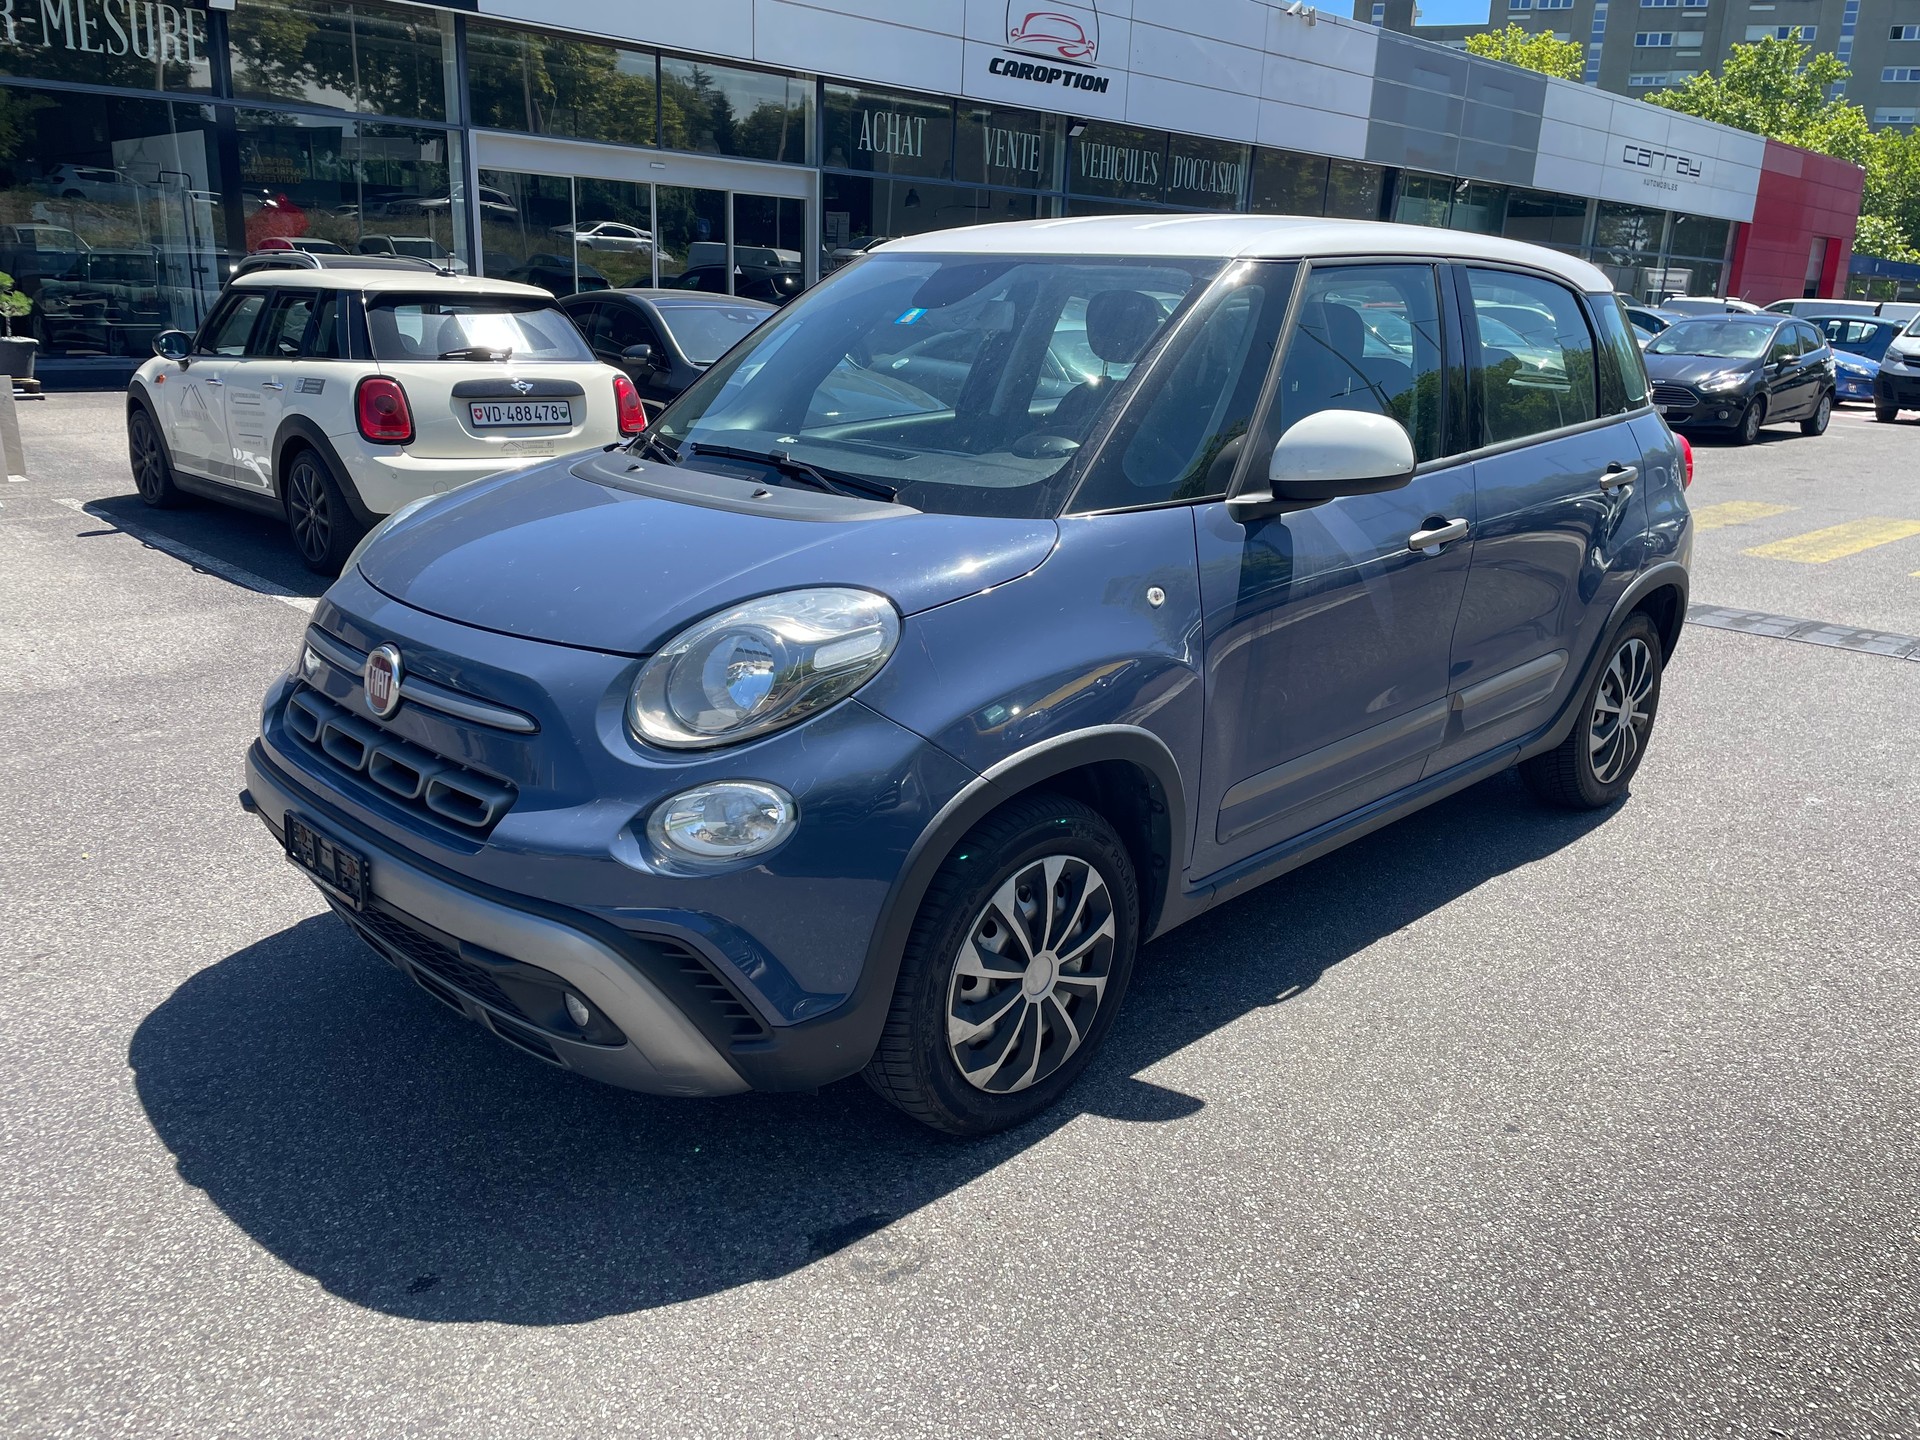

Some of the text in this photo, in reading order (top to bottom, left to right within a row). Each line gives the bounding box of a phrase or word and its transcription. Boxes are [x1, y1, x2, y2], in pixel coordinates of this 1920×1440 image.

[988, 57, 1110, 94] CAROPTION
[857, 109, 1245, 195] ACHAT VENTE VEHICULES D'OCCASION
[1642, 178, 1678, 192] AUTOMOBILES
[369, 663, 391, 700] FIAT
